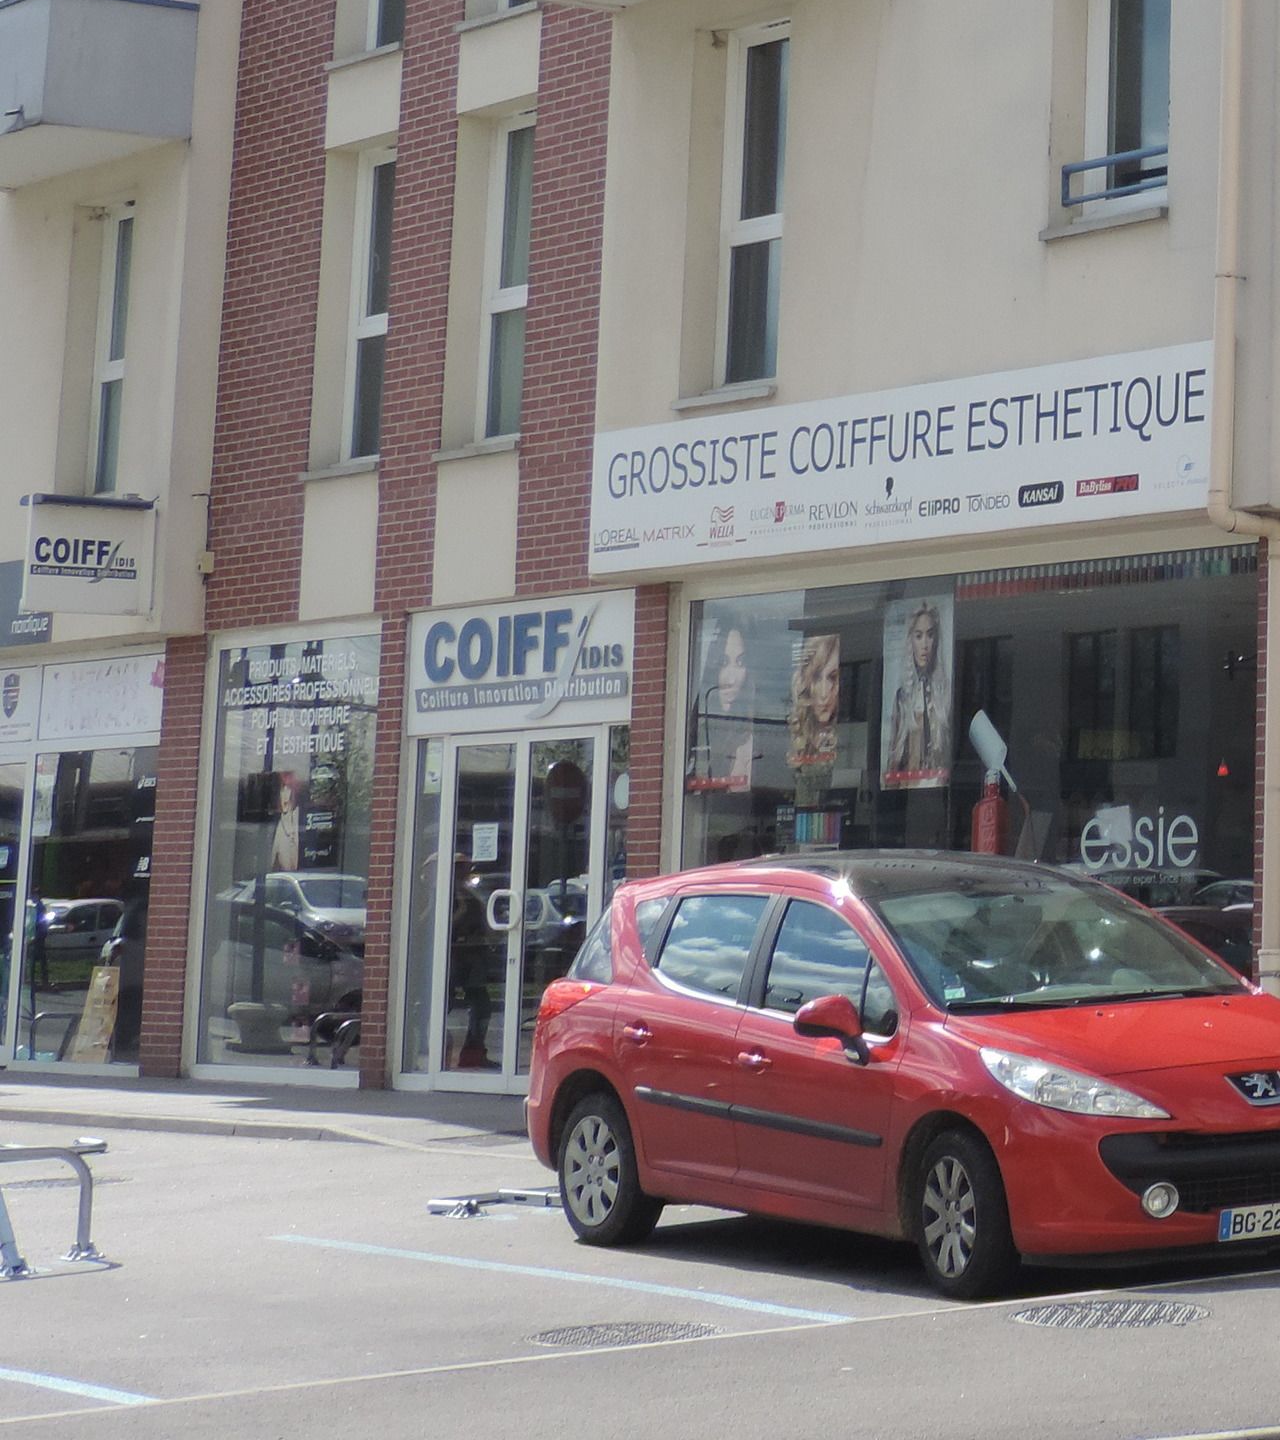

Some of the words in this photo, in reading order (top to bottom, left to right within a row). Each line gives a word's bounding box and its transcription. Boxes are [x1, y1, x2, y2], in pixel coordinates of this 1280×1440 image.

[607, 431, 778, 500] GROSSISTE
[789, 405, 956, 476] COIFFURE
[966, 368, 1207, 452] ESTHETIQUE
[642, 523, 696, 543] MATRIX
[709, 524, 735, 540] WELLA
[808, 499, 858, 522] REVLON
[114, 558, 135, 568] IDIS
[581, 643, 624, 670] IDIS
[223, 682, 292, 707] ACCESSOIRES
[420, 689, 470, 709] Coiffure
[473, 682, 540, 706] Innovation
[251, 711, 278, 730] POUR
[282, 710, 296, 728] LA
[301, 705, 351, 728] COIFFURE
[256, 737, 270, 756] ET
